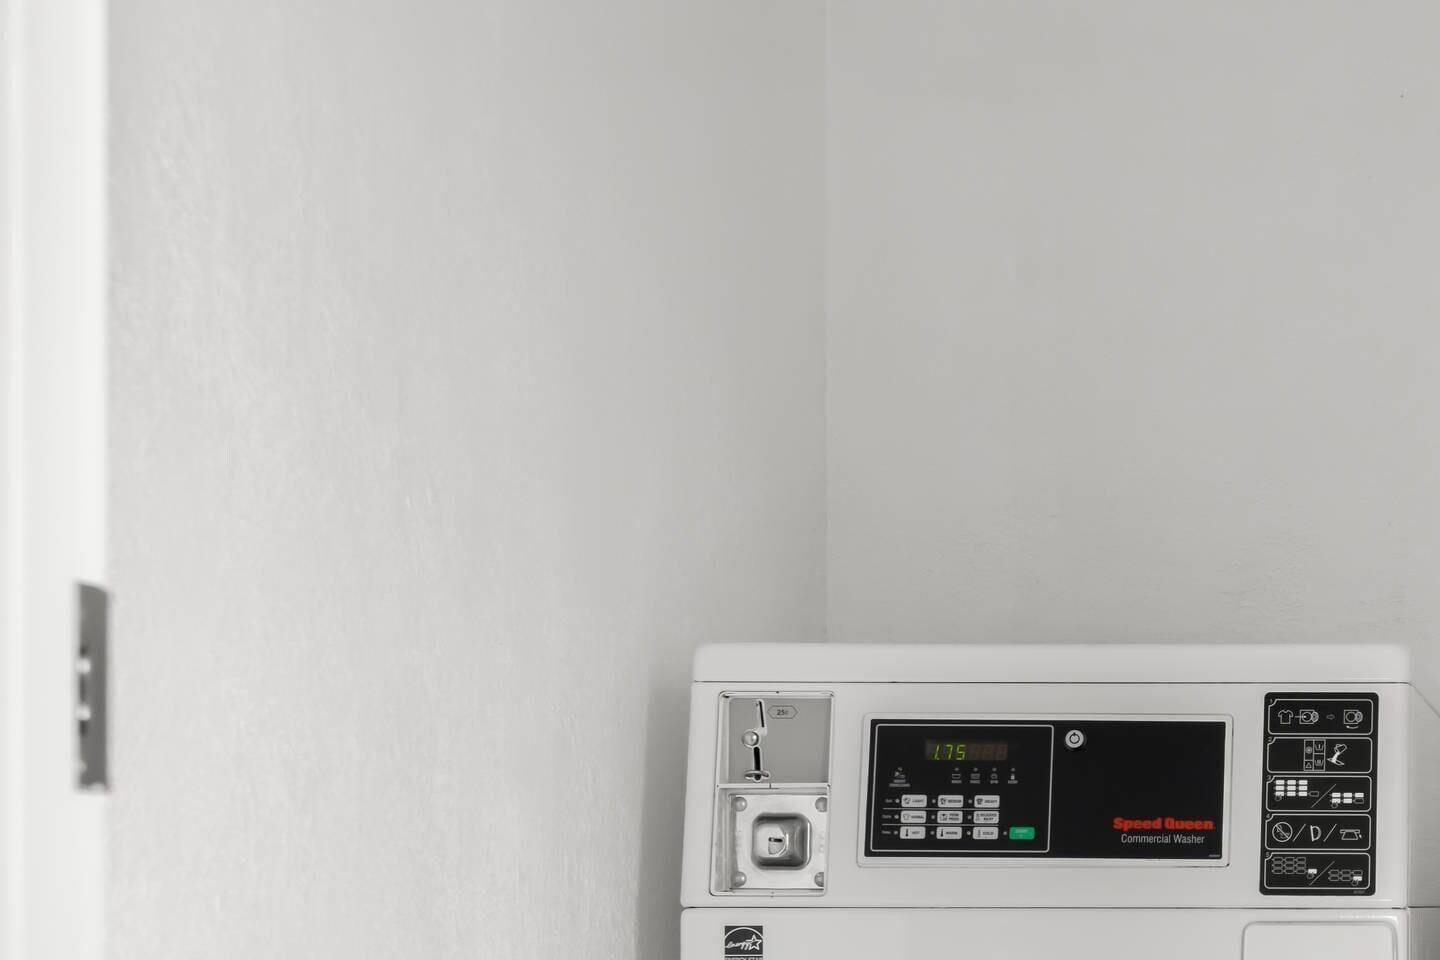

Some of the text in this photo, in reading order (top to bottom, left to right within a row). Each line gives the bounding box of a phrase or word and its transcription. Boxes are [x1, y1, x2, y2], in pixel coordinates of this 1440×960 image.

[934, 744, 966, 761] 1.75
[1113, 817, 1214, 831] Speed Queen
[1121, 834, 1205, 844] Commercial Washer
